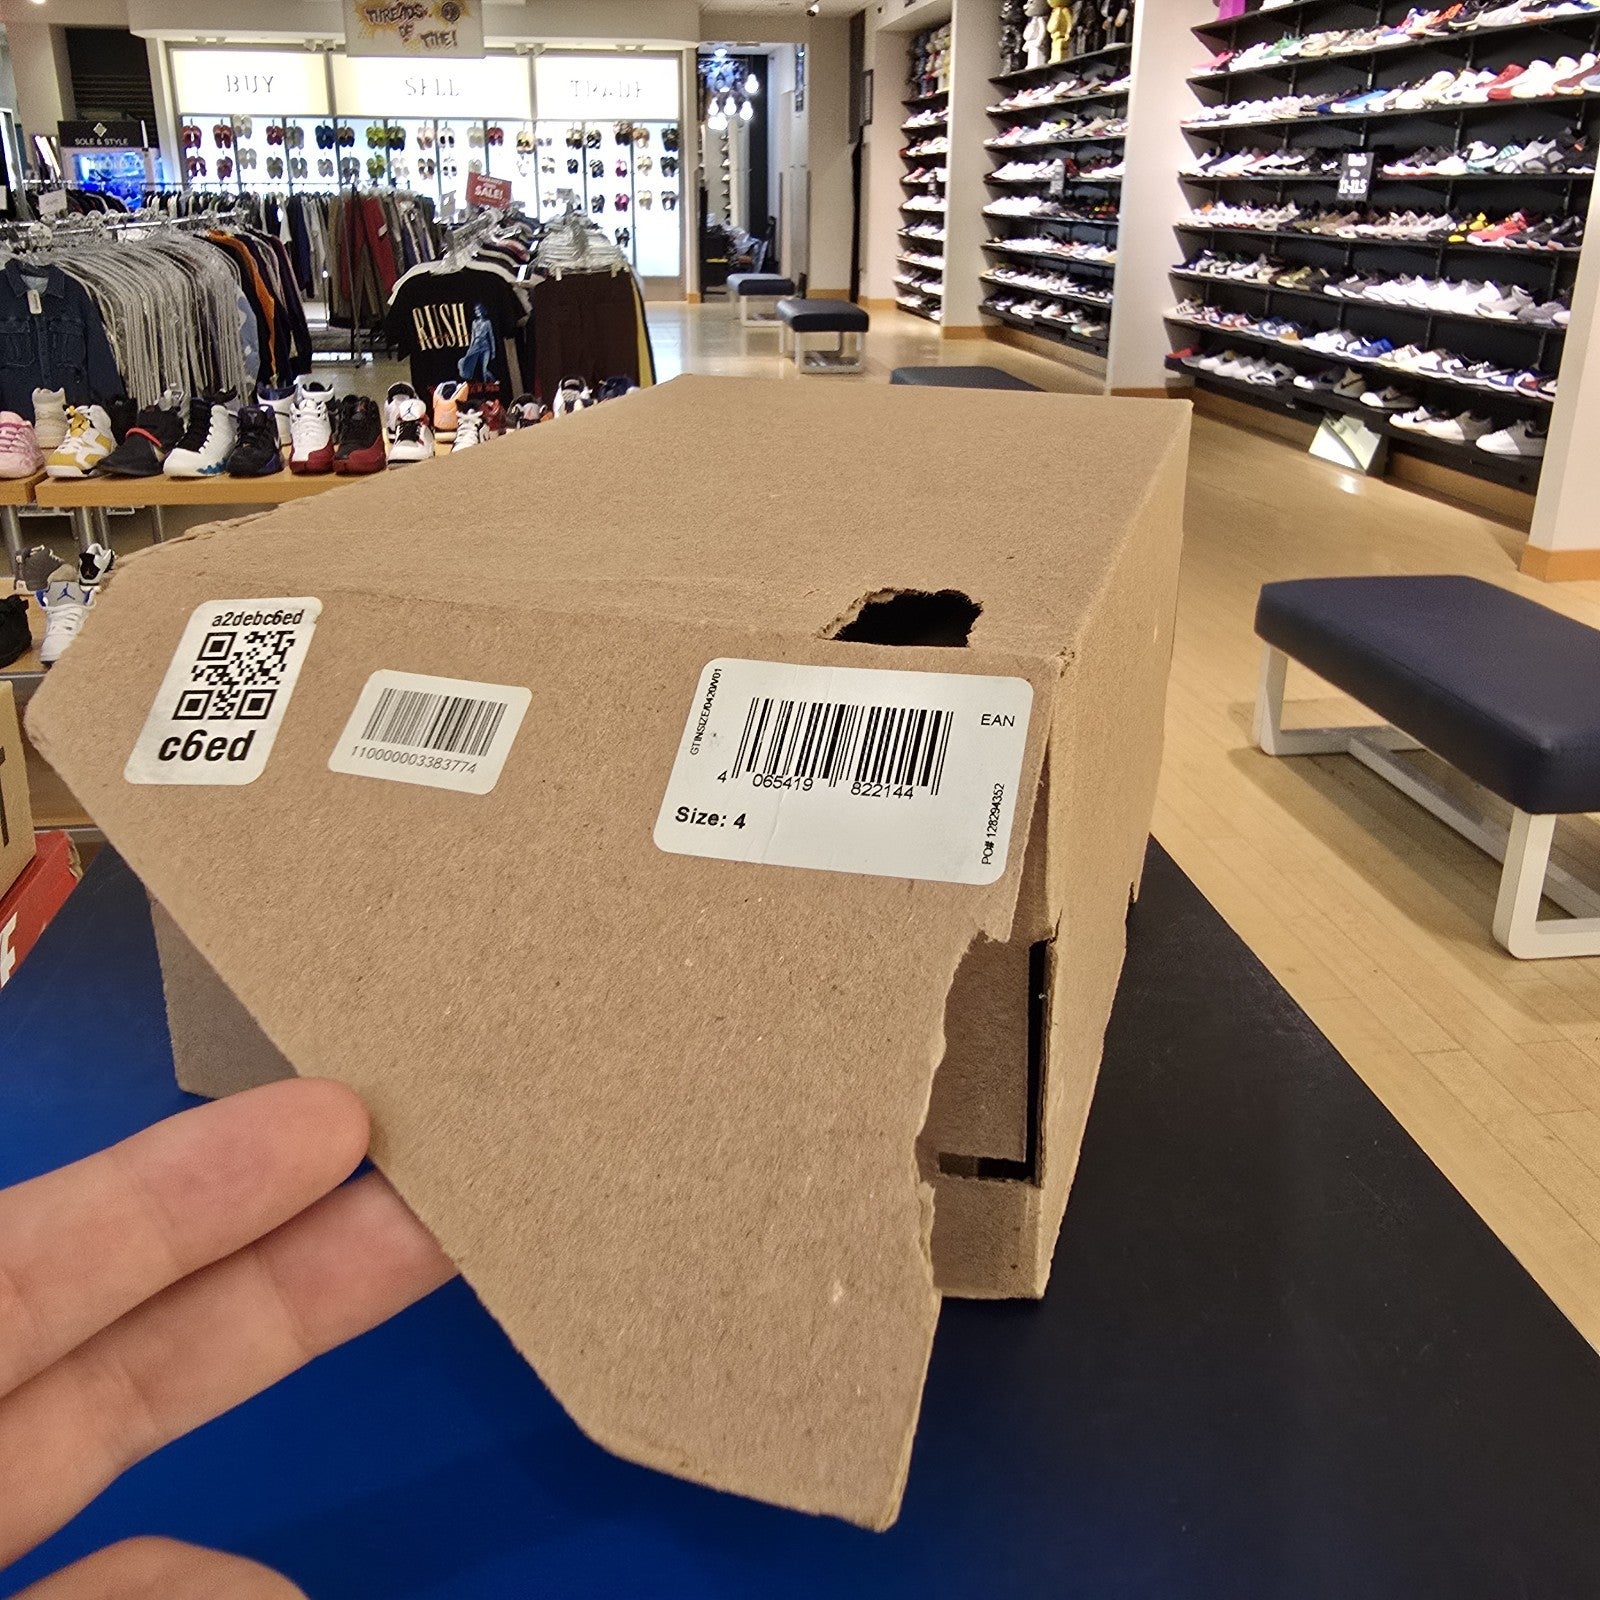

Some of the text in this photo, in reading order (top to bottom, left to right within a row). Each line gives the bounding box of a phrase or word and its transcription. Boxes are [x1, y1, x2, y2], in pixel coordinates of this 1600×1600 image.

[226, 74, 274, 94] BUY
[474, 185, 504, 200] SALE!
[412, 303, 470, 351] RUSH
[212, 609, 304, 628] a2debc6ed
[980, 713, 1016, 728] EAN
[158, 729, 256, 763] c6ed
[351, 745, 478, 775] 110000003383774
[716, 770, 914, 800] 4 065419 822144
[674, 806, 747, 831] Size: 4
[981, 782, 1005, 866] PO# 128294352
